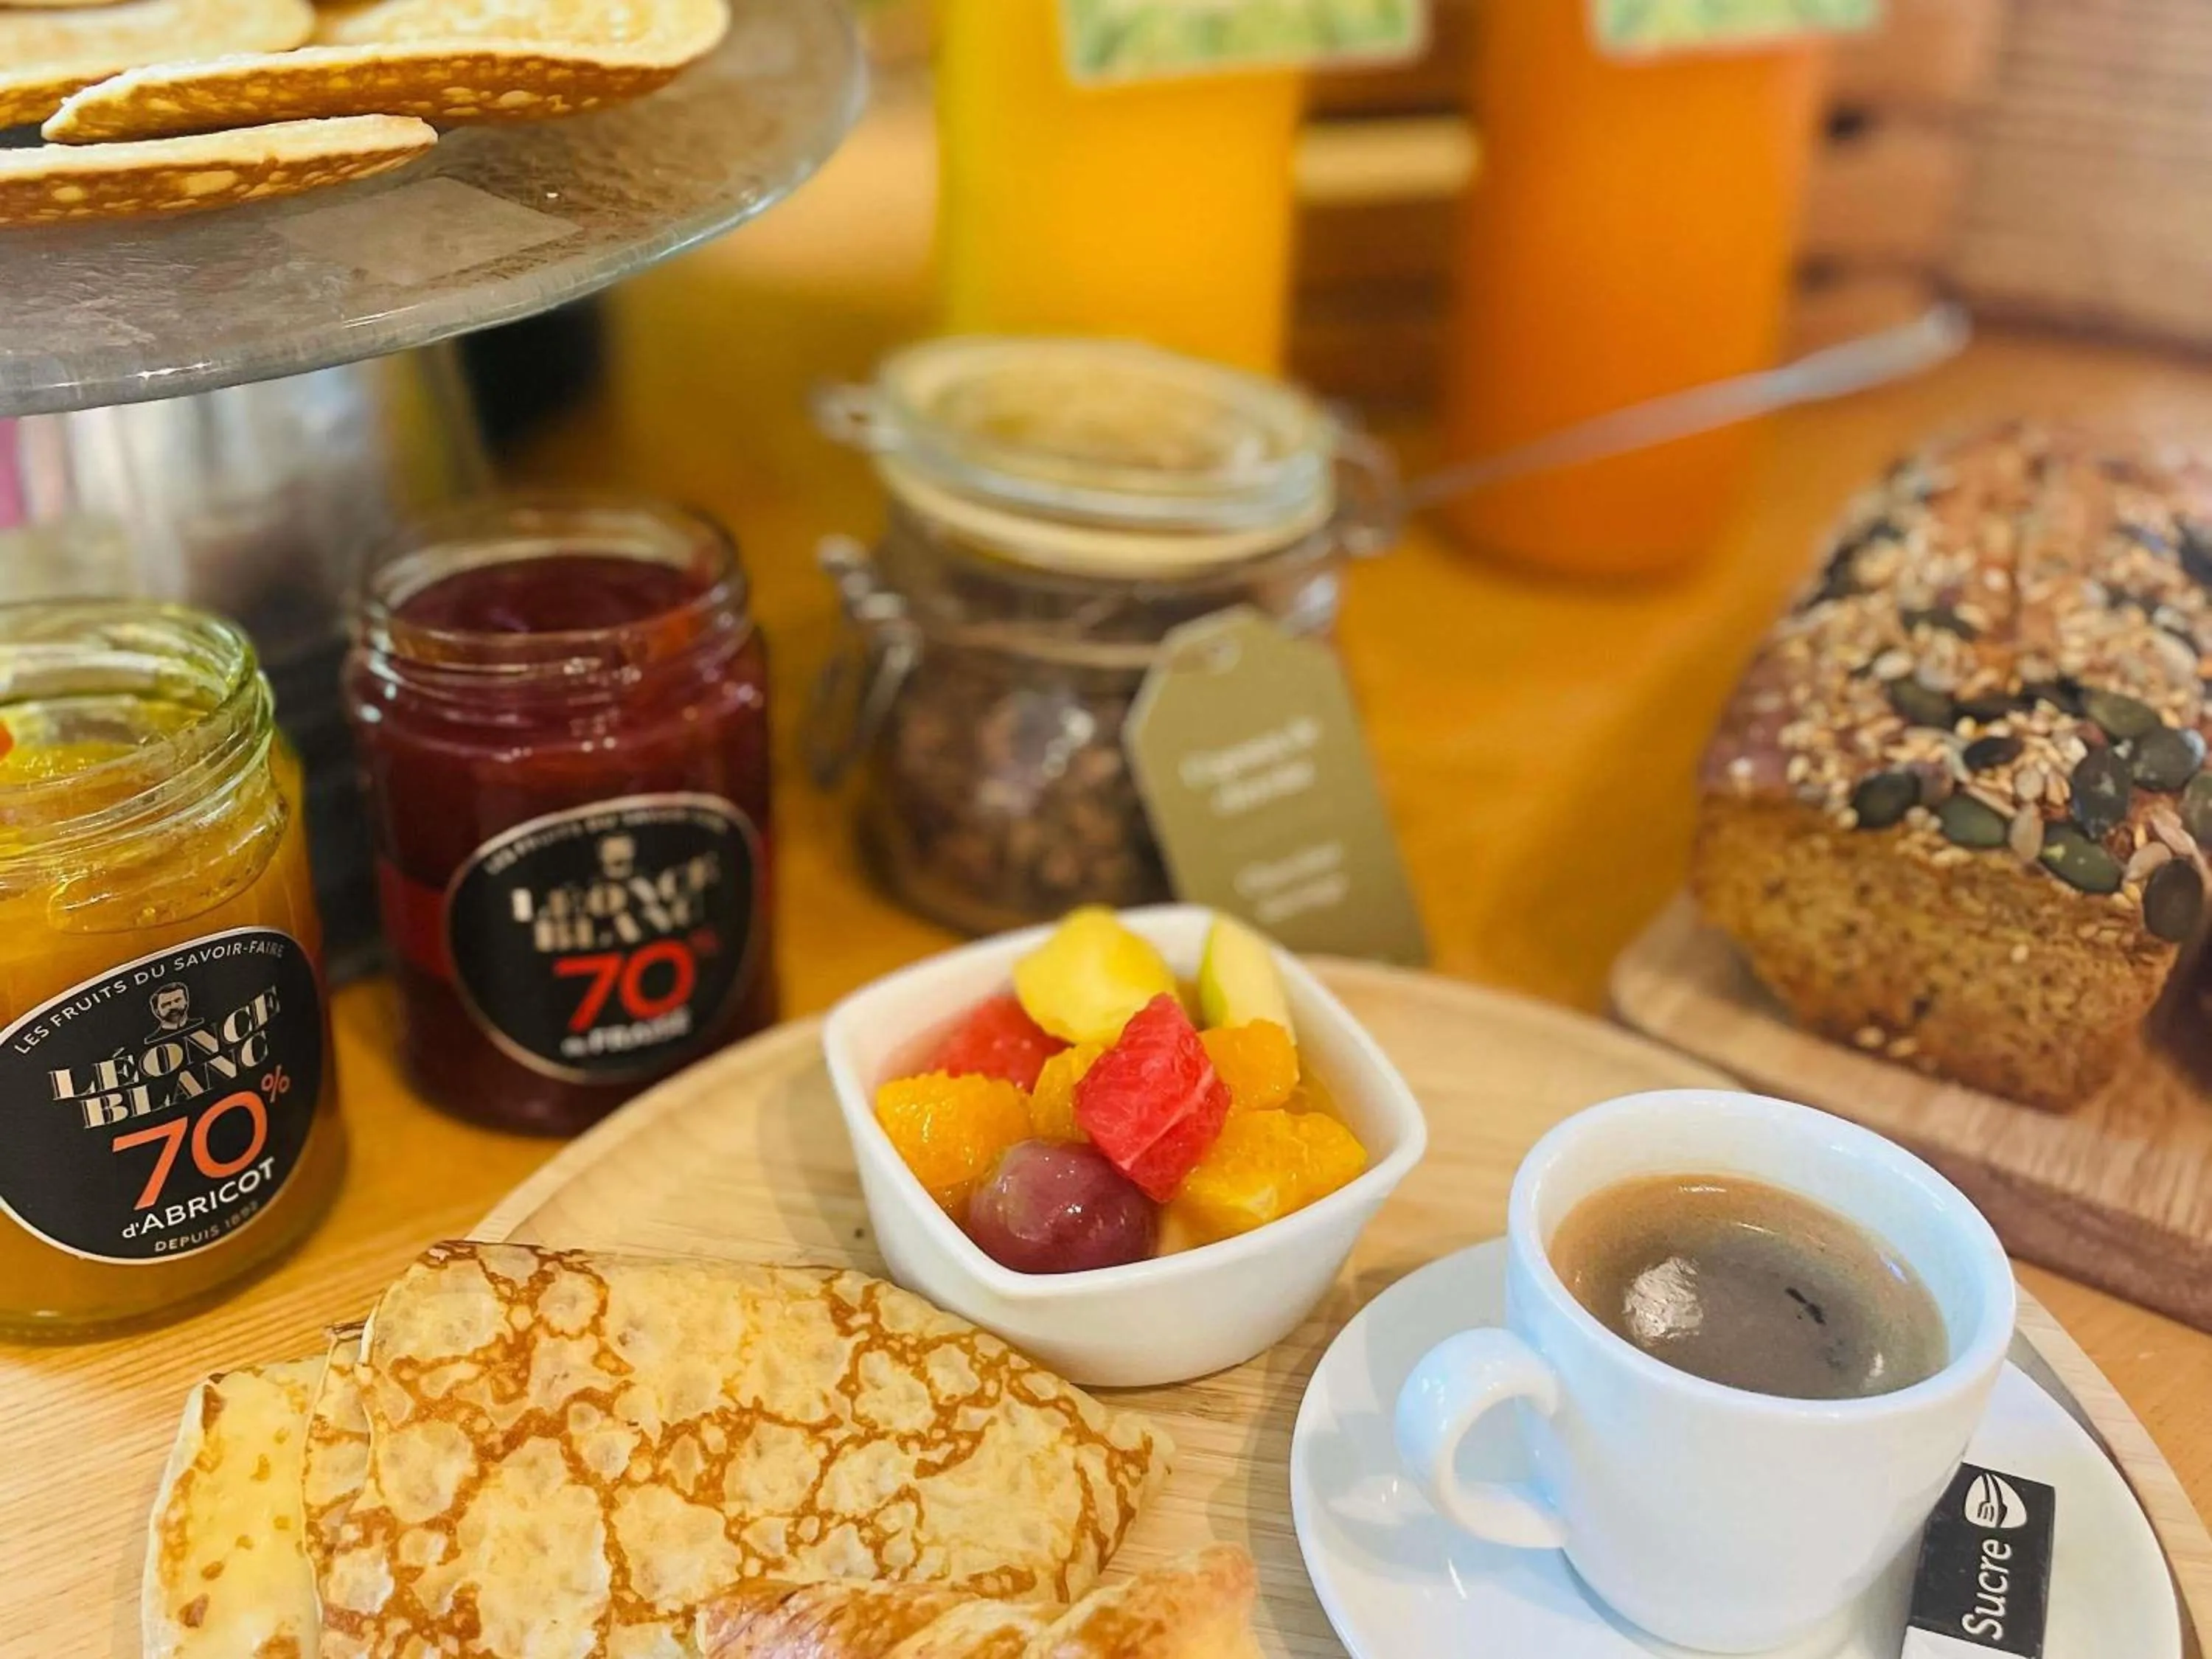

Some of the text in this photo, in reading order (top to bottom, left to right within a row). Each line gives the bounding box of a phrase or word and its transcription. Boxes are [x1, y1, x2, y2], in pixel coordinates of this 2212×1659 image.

[14, 940, 285, 1054] LES FRUITS DU SAVOIR-FAIRE
[48, 984, 280, 1101] LÉONCE
[82, 1029, 269, 1129] BLANC
[122, 1157, 275, 1239] d'ABRICOT
[154, 1224, 220, 1252] DEPUIS
[1961, 1539, 2012, 1641] Sucre
